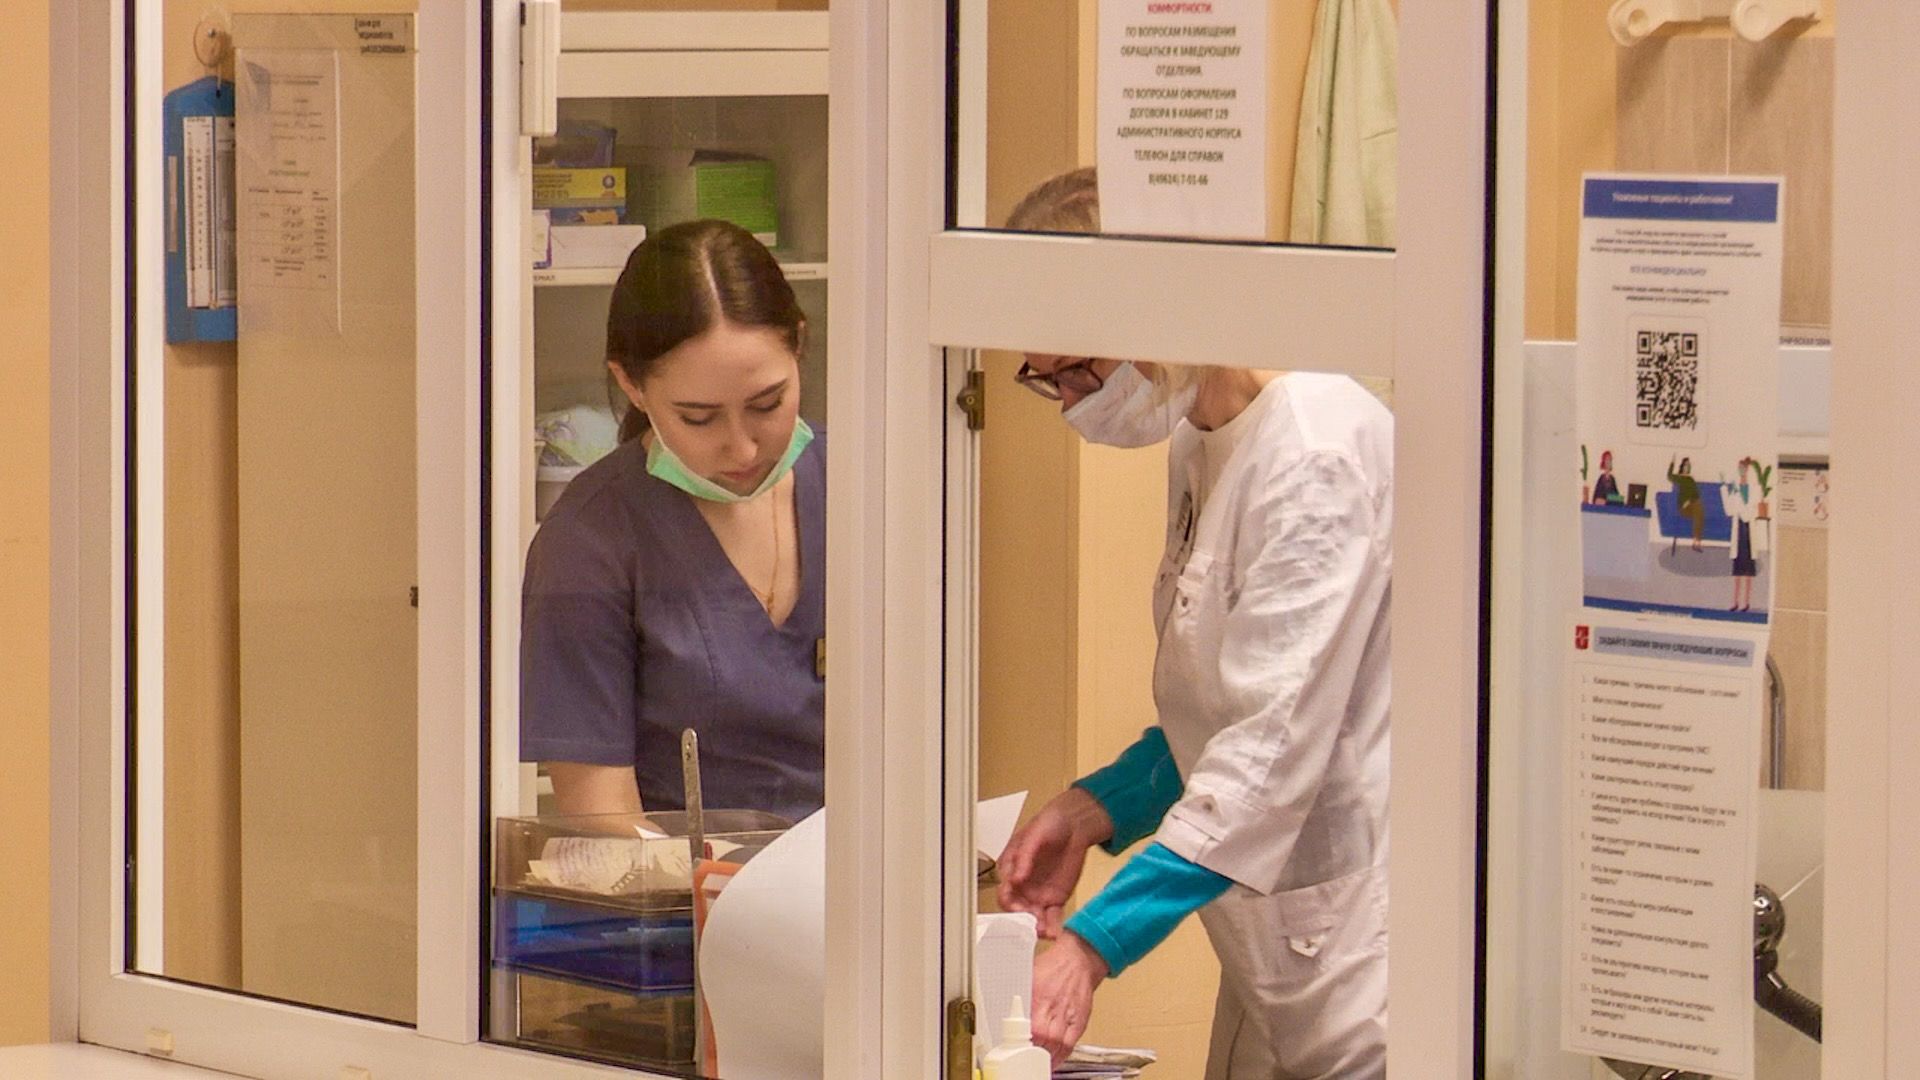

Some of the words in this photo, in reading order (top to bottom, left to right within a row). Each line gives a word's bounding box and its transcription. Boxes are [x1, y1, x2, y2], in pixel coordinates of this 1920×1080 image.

[1125, 27, 1136, 37] ПО
[1138, 27, 1181, 37] ВОПРОСАМ
[1183, 27, 1236, 38] РАЗМЕЩЕНИЯ
[1120, 46, 1171, 57] ОБРАЩАТЬСЯ
[1173, 46, 1178, 56] К
[1180, 46, 1241, 57] ЗАВЕДУЮЩЕМУ
[1123, 88, 1134, 99] ПО
[1136, 88, 1178, 99] ВОПРОСАМ
[1180, 89, 1236, 99] ОФОРМЛЕНИЯ
[1129, 107, 1170, 119] ДОГОВОРА
[1172, 108, 1177, 119] В
[1179, 108, 1213, 119] КАБИНЕТ
[1215, 108, 1228, 119] 129
[1117, 127, 1204, 139] АДМИНИСТРАТИВНОГО
[1206, 128, 1241, 139] КОРПУСА
[1134, 150, 1168, 161] ТЕЛЕФОН
[1169, 150, 1186, 162] ДЛЯ
[1188, 151, 1223, 162] СПРАВОК
